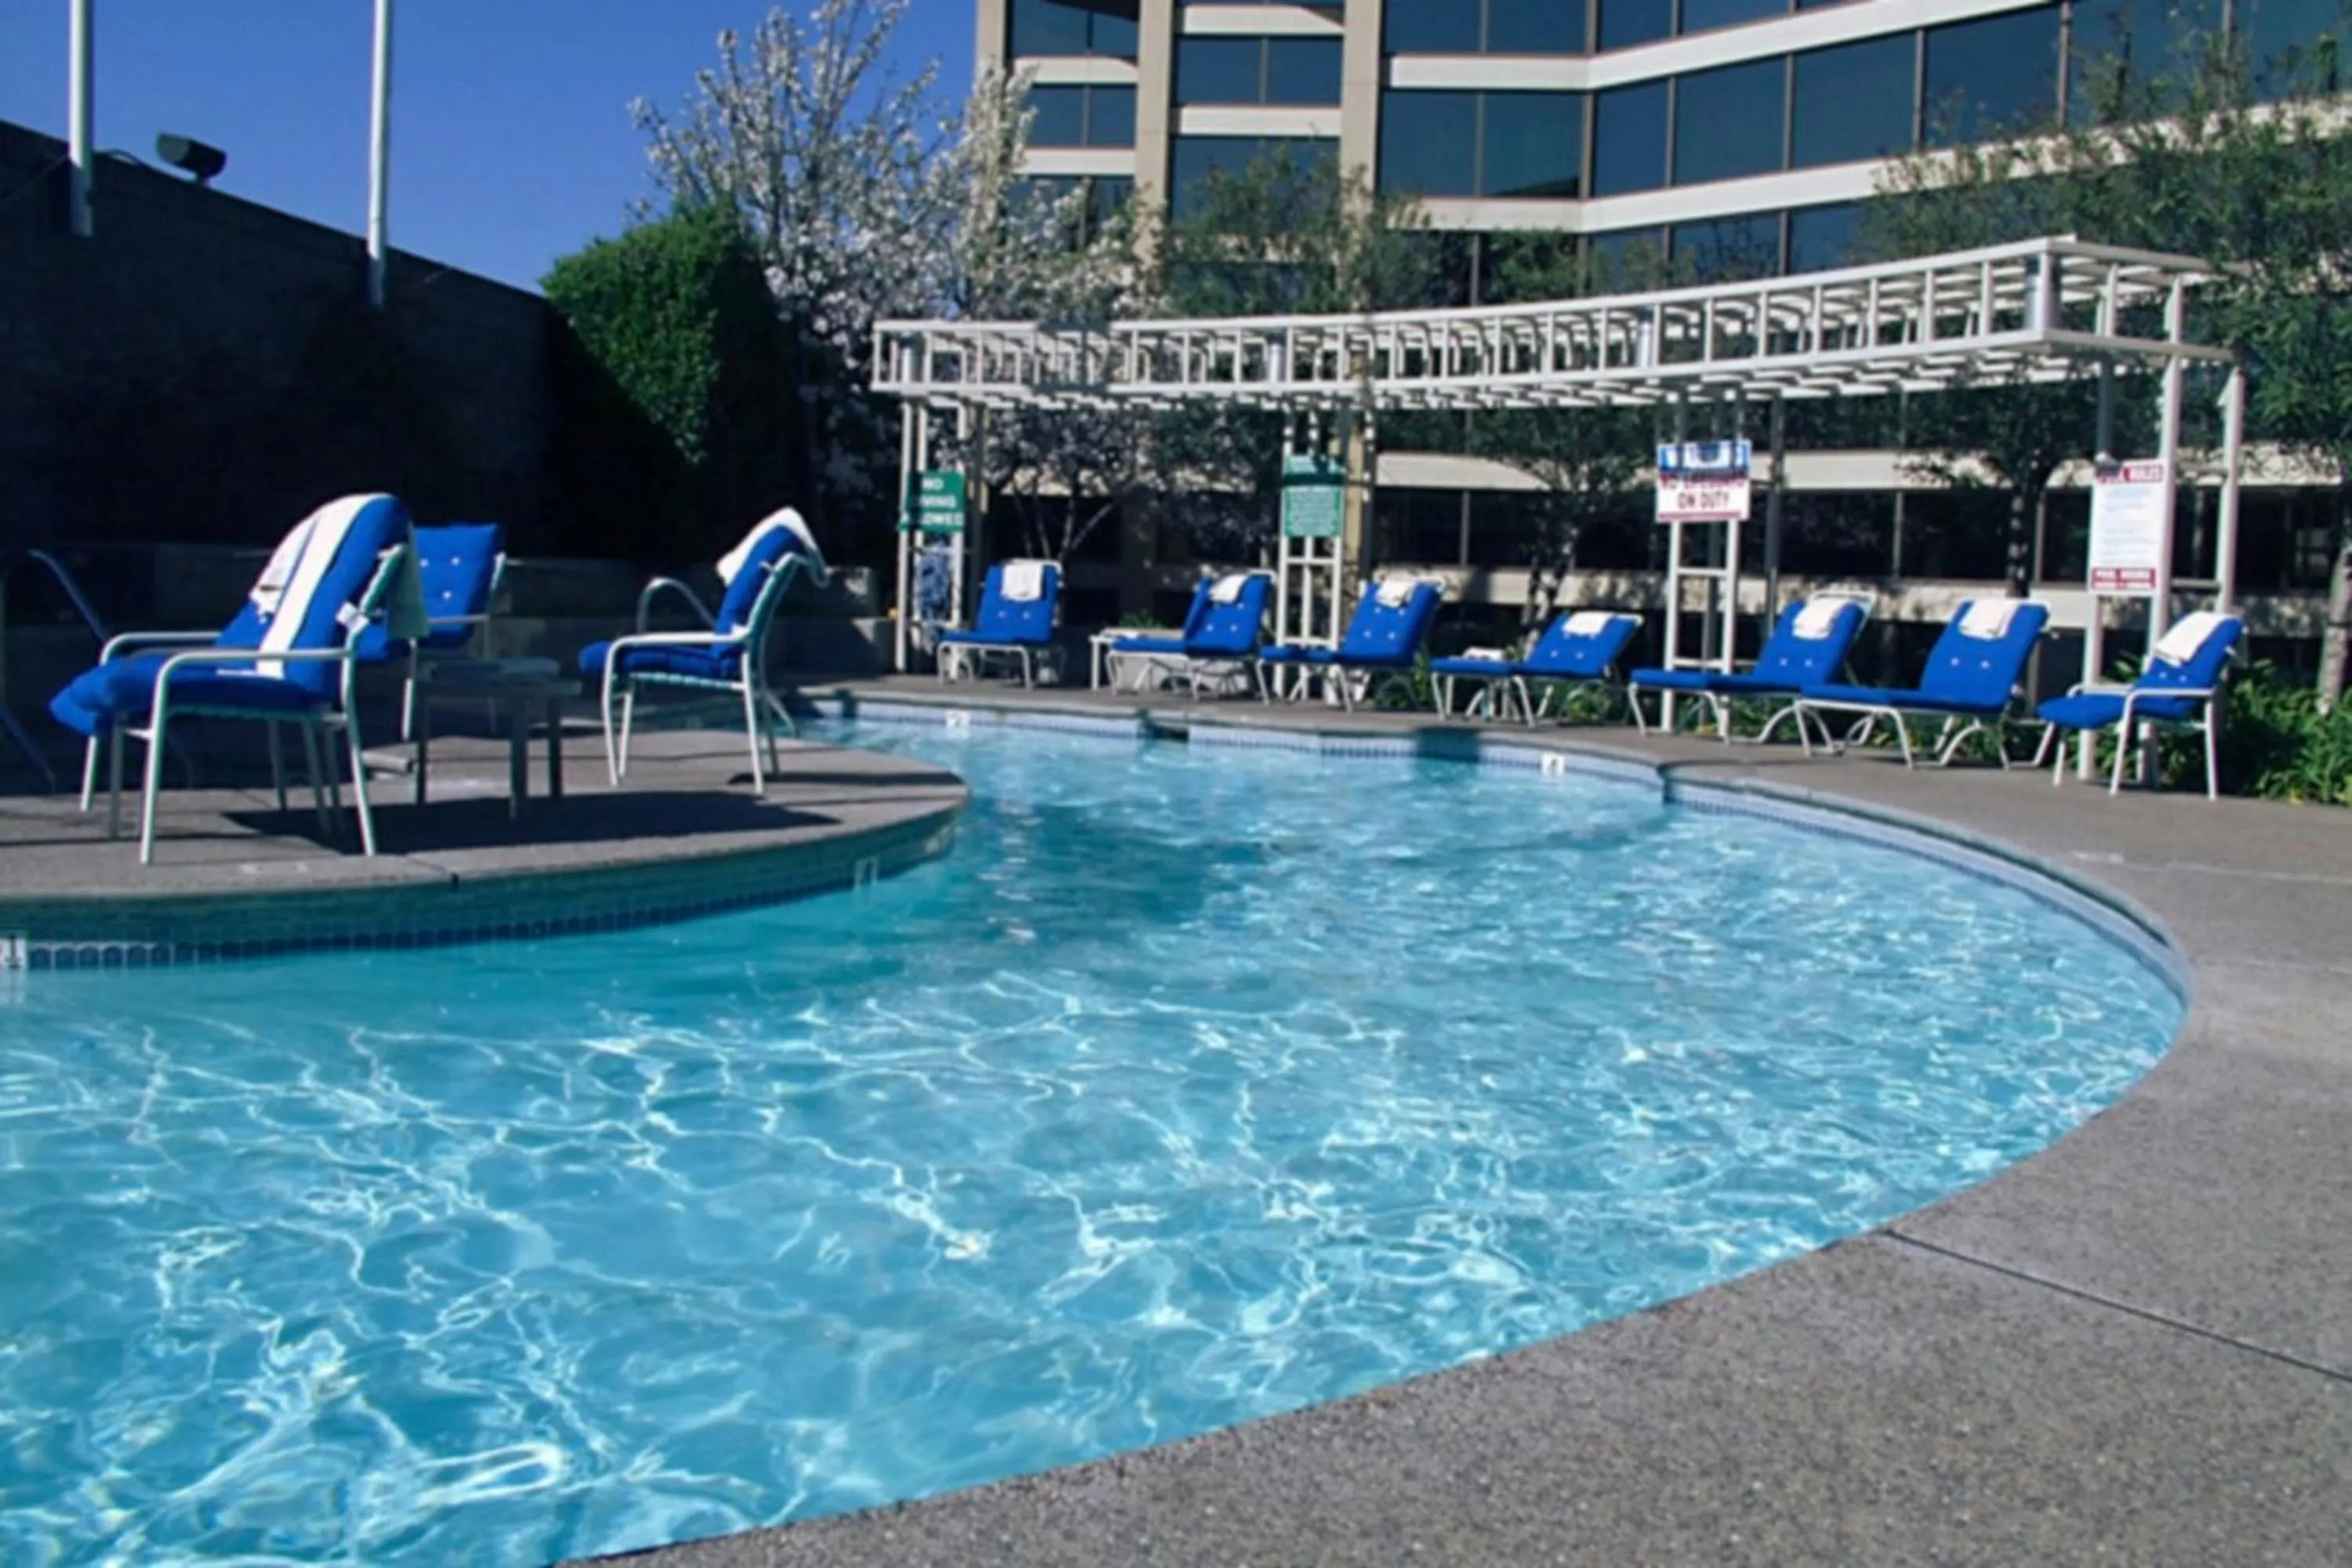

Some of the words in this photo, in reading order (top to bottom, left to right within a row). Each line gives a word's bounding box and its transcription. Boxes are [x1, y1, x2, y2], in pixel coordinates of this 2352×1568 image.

[921, 477, 944, 491] NO
[1678, 492, 1695, 509] ON
[1700, 491, 1729, 508] DUTY
